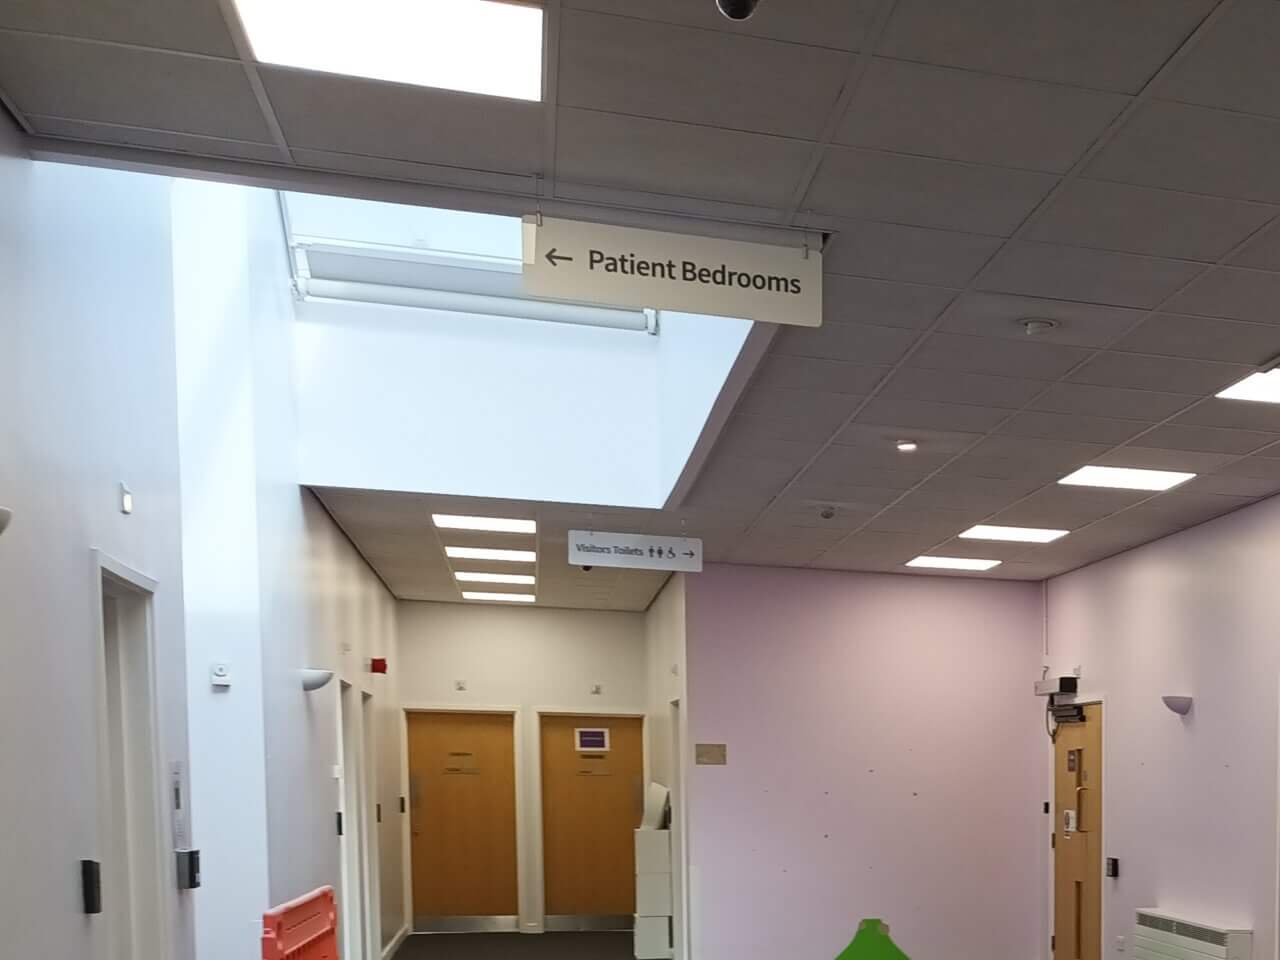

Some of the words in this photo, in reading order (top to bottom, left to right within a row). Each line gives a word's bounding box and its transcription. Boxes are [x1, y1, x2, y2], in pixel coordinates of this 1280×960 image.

[588, 249, 677, 281] Patient
[681, 260, 801, 295] Bedrooms
[576, 543, 612, 554] Visitors
[612, 545, 644, 556] Toilets
